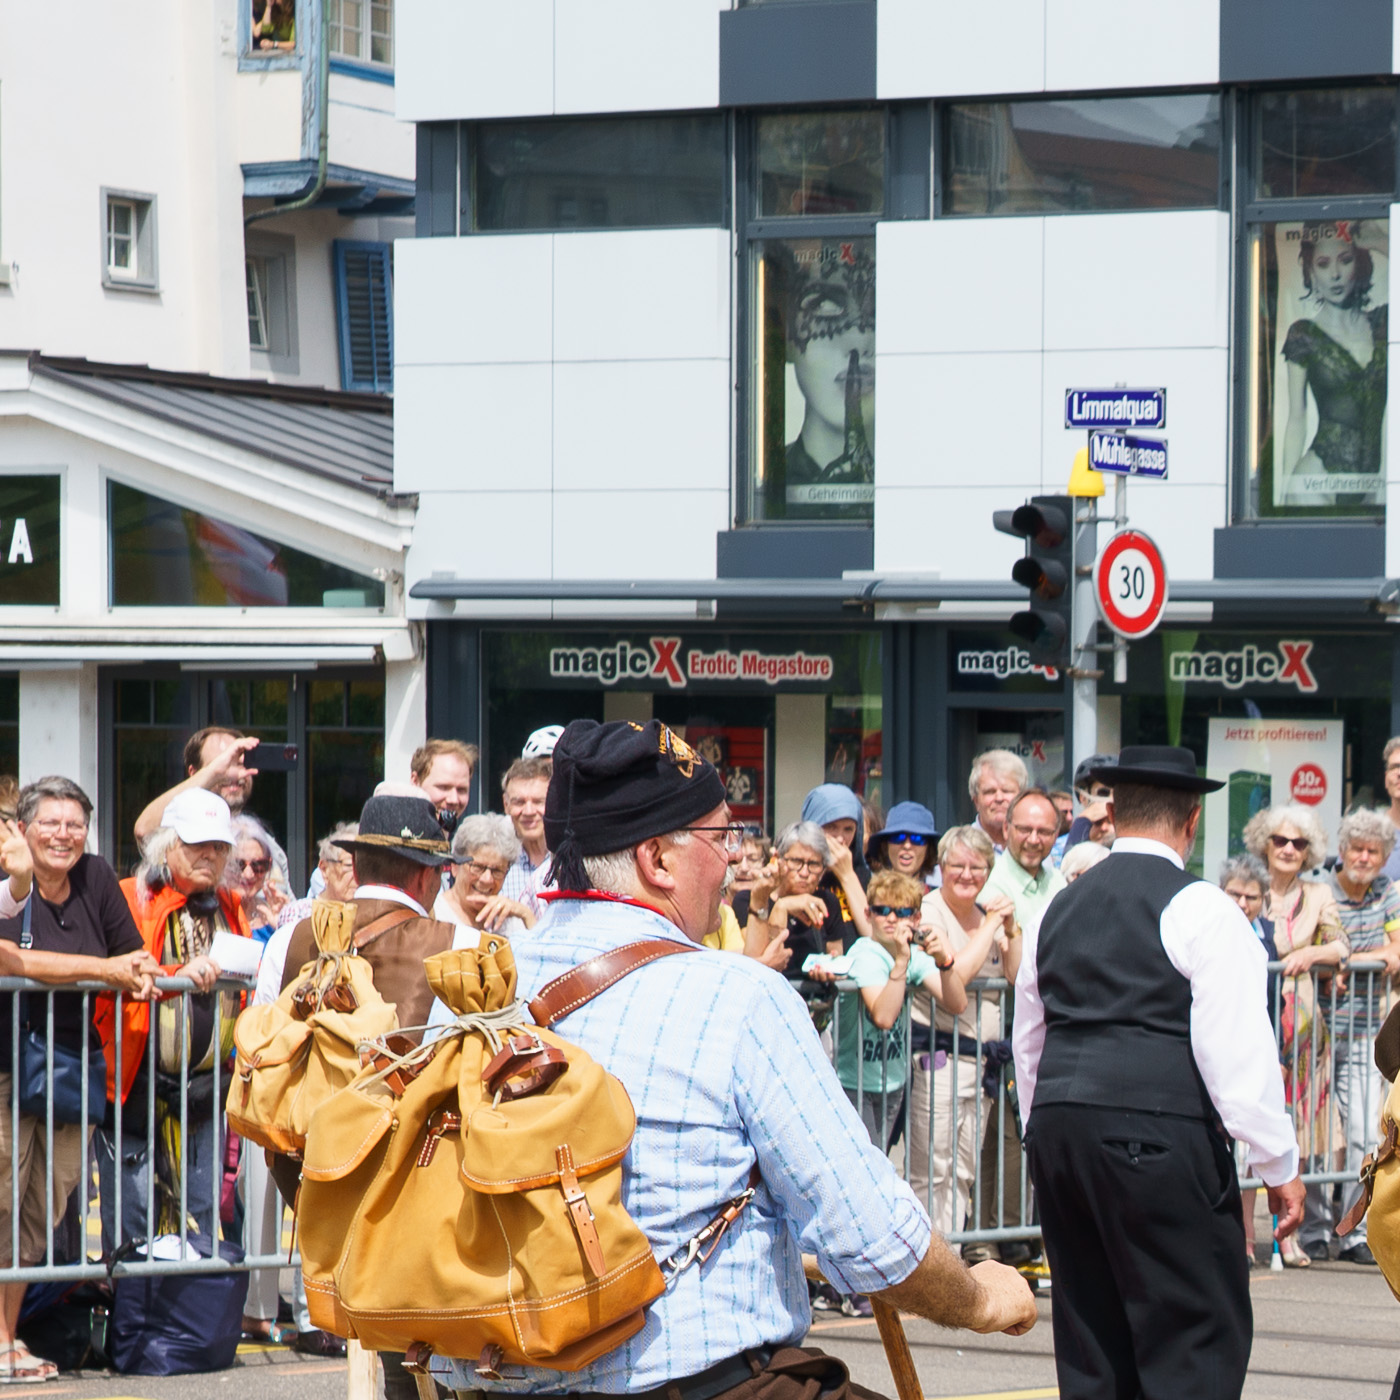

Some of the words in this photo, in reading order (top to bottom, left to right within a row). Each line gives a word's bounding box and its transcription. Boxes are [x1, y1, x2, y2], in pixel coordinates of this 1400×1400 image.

[1285, 221, 1352, 242] magicX
[1073, 392, 1158, 426] Limmatquai
[1093, 435, 1166, 473] Mühlegasse
[0, 518, 34, 564] A
[1120, 565, 1145, 600] 30
[553, 640, 685, 684] magicX
[689, 653, 737, 675] Erotic
[741, 652, 831, 679] Megastore
[1173, 642, 1315, 689] magicX
[1225, 727, 1255, 741] Jetzt
[1258, 727, 1328, 742] profitieren!
